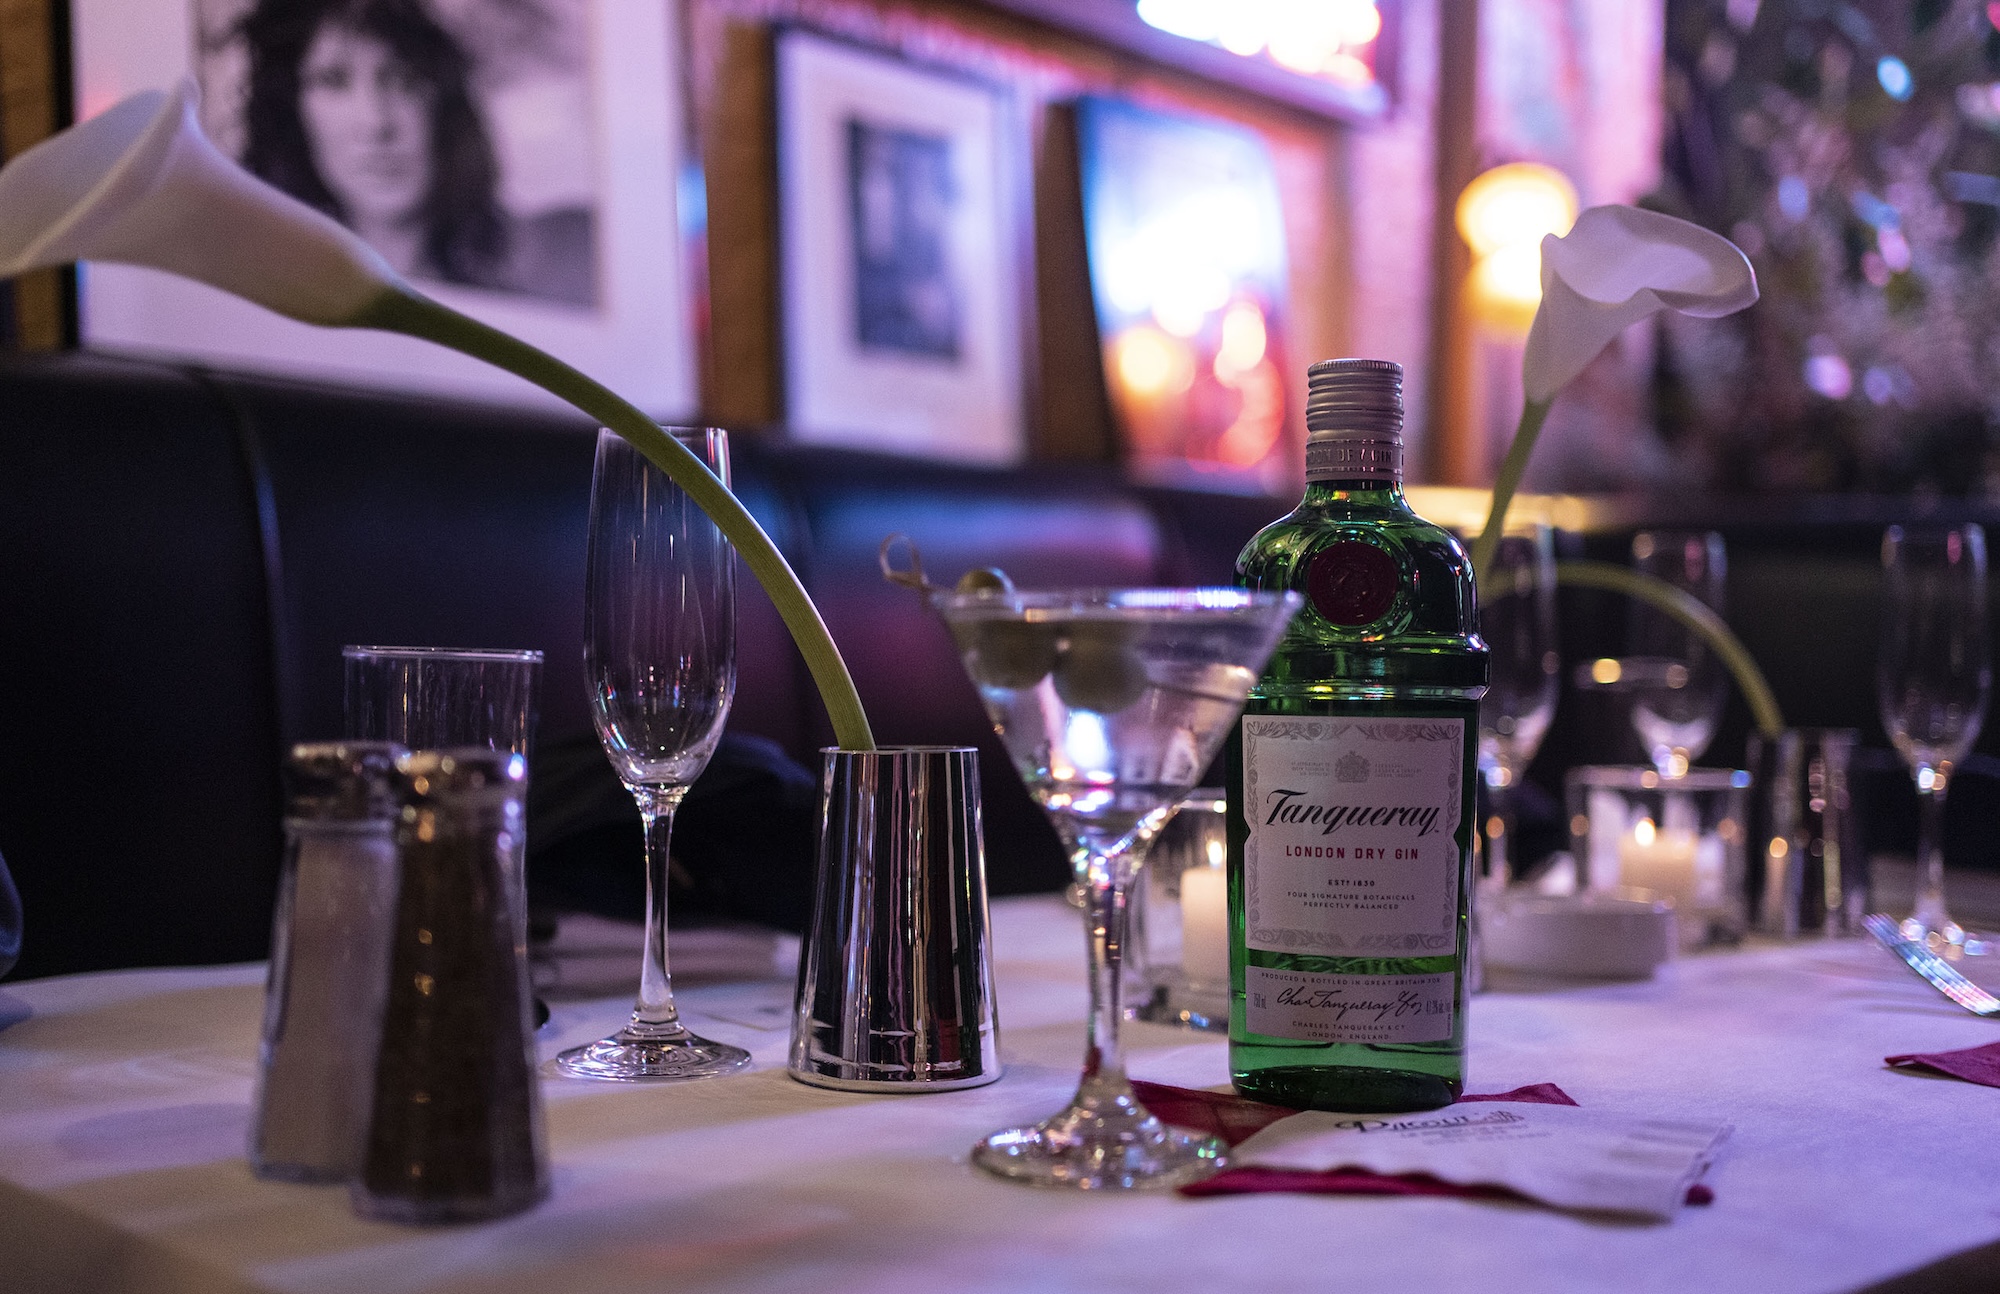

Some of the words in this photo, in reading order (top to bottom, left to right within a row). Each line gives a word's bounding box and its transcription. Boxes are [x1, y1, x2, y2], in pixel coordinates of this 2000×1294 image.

[1265, 789, 1440, 837] Tanqueray
[1286, 845, 1345, 859] LONDON
[1355, 848, 1385, 859] DRY
[1395, 848, 1418, 860] GIN
[1311, 892, 1359, 900] SIGNATURE
[1303, 901, 1350, 909] PERFECTLY
[1261, 972, 1299, 982] PRODUCED
[1311, 977, 1348, 985] BOTTLED
[1292, 1020, 1329, 1030] CHARLES
